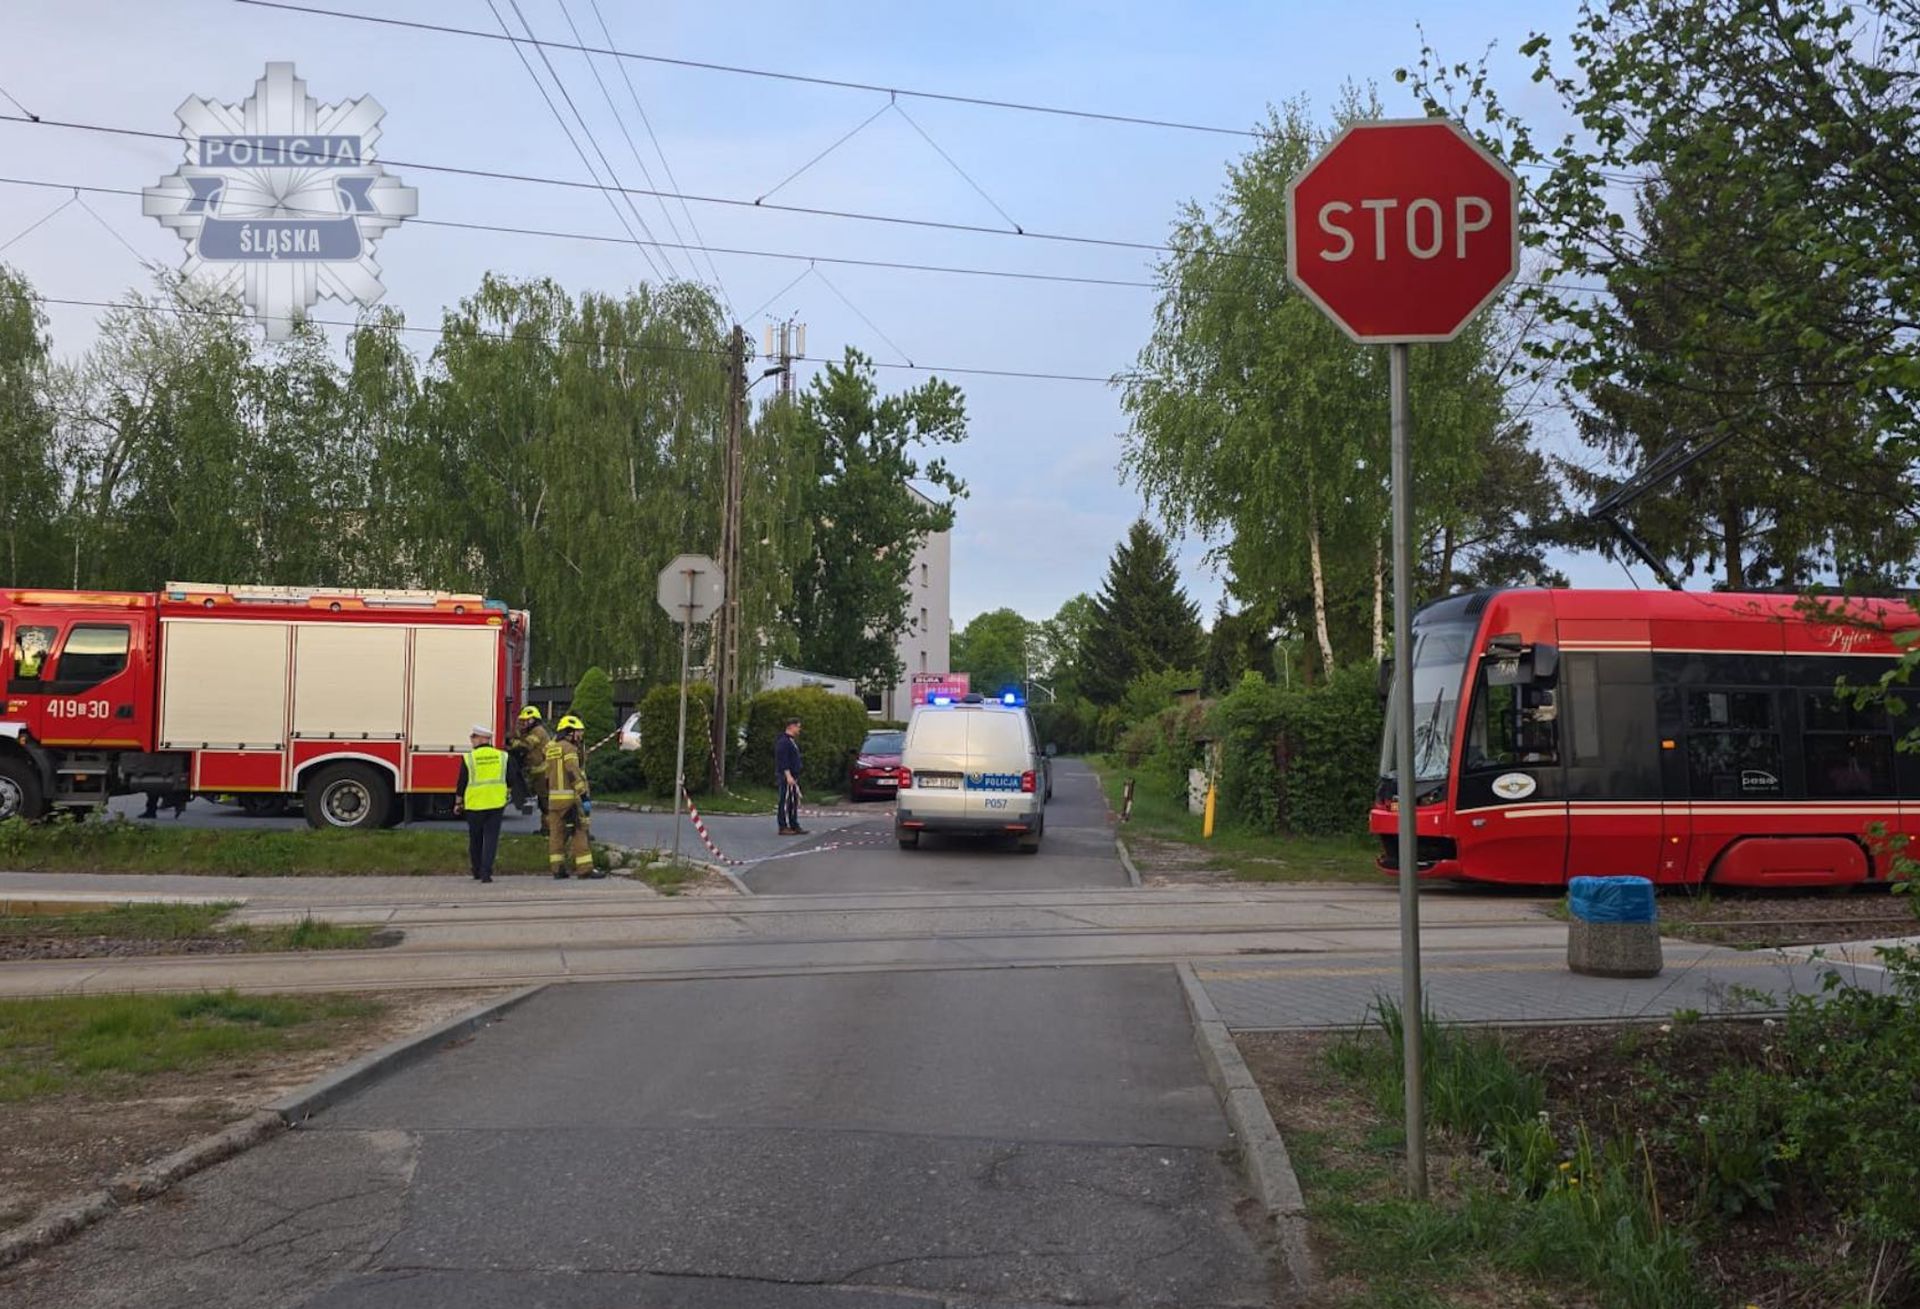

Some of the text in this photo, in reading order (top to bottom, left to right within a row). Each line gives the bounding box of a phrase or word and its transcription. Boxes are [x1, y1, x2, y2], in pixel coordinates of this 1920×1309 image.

[1317, 196, 1493, 262] STOP
[984, 777, 1019, 788] POLICJA
[984, 798, 1008, 809] P057
